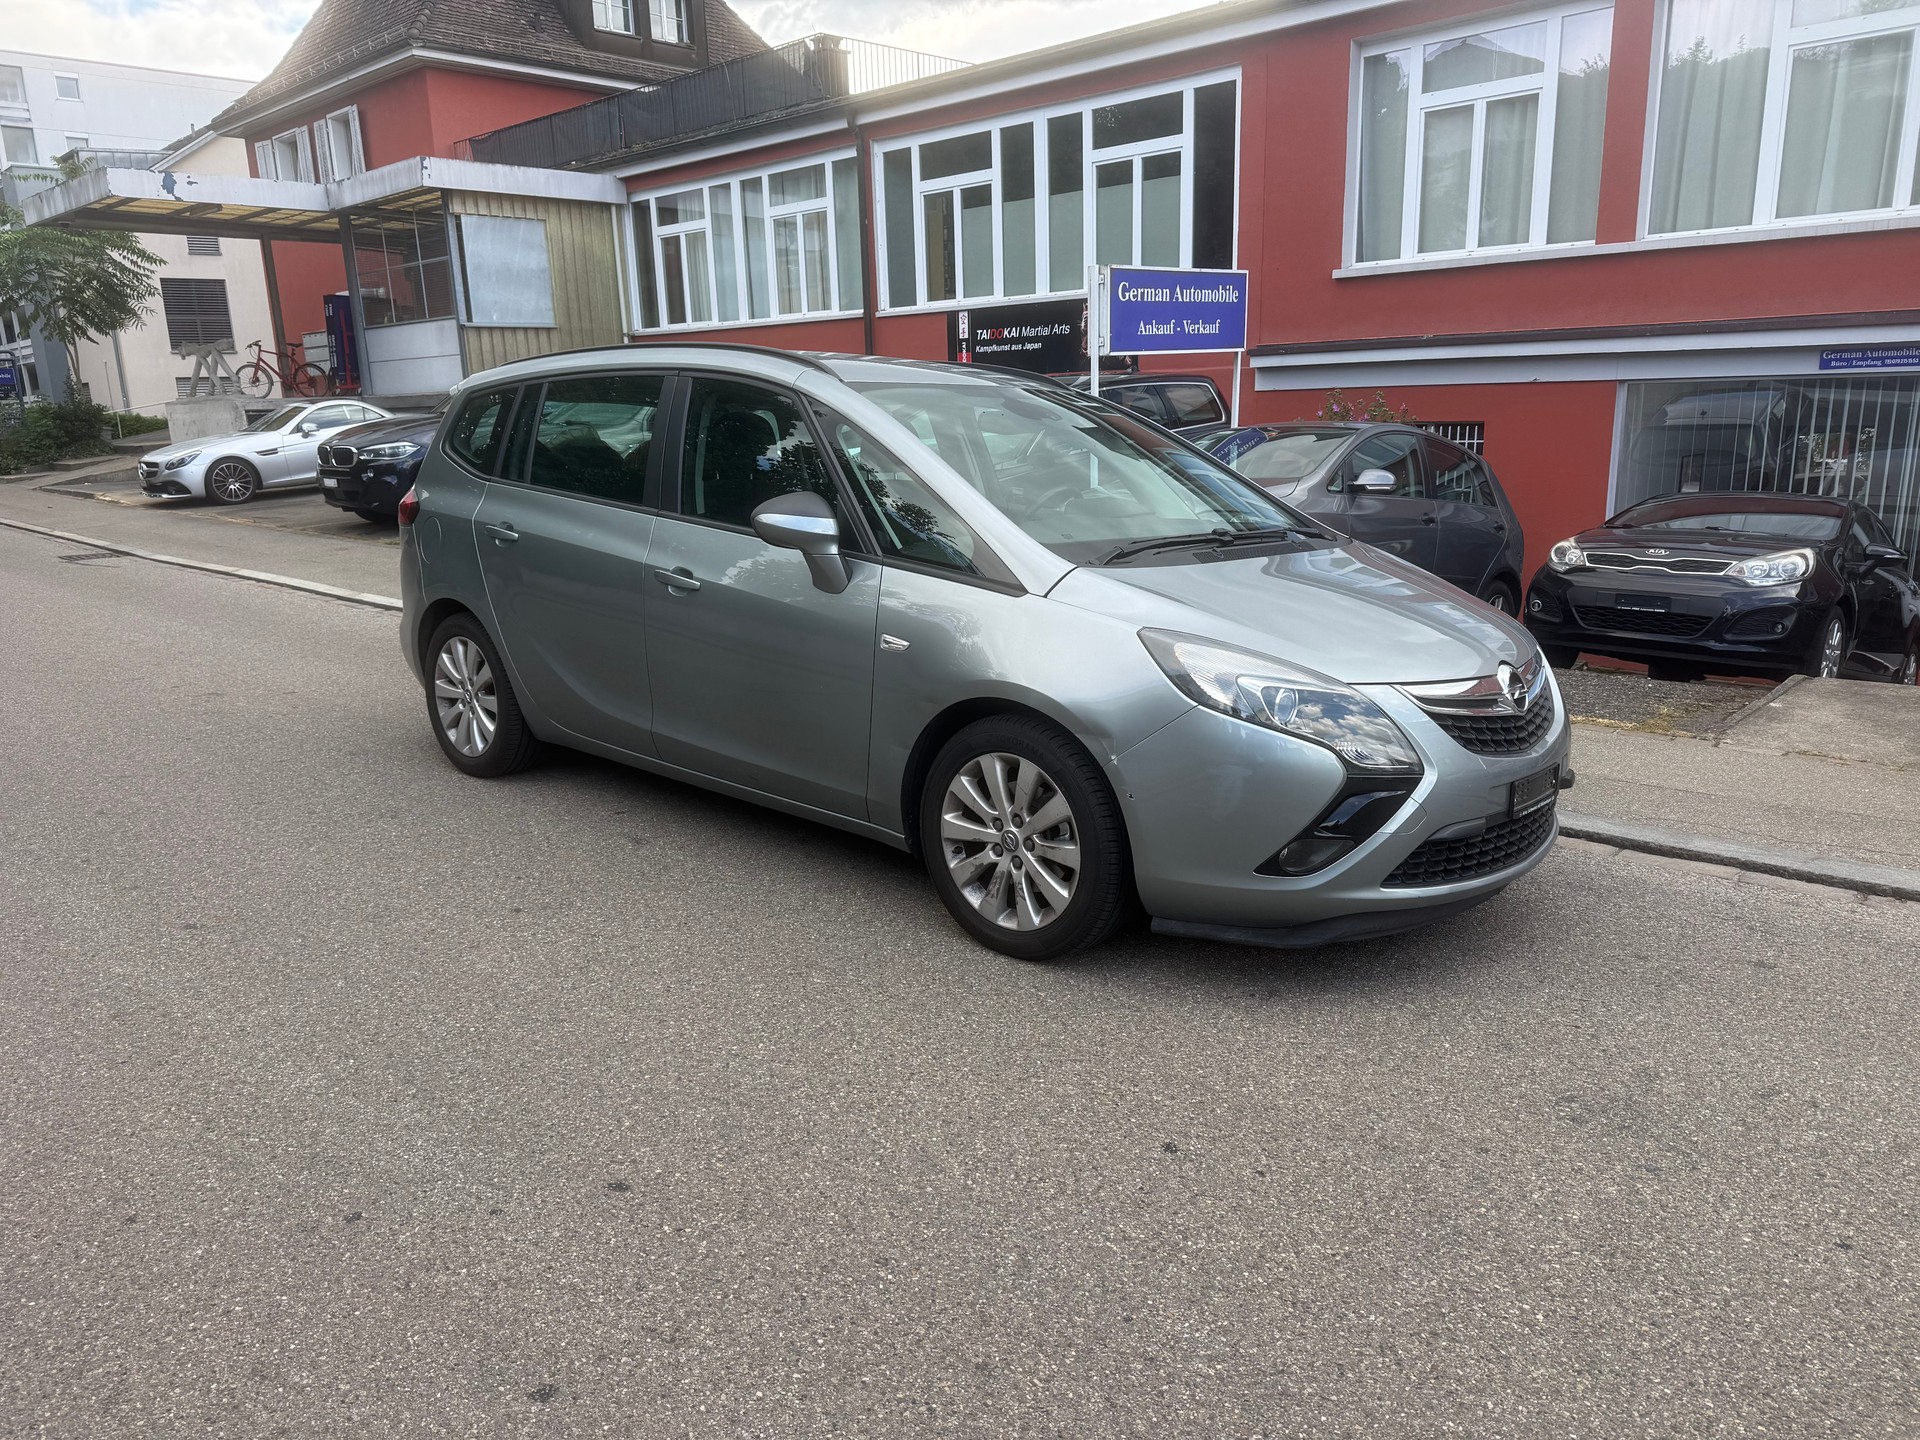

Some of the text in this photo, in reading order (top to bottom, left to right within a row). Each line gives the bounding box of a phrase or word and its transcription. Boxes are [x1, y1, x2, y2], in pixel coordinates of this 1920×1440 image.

[1118, 281, 1239, 303] German Automobile
[976, 323, 1071, 340] TAIDOKAI Martial Arts
[1137, 319, 1175, 335] Ankauf
[1182, 319, 1221, 334] Verkauf
[975, 343, 1011, 353] Kampfkunst
[1022, 341, 1042, 351] Japan
[1822, 347, 1920, 359] German Automobile
[1852, 359, 1882, 367] Empfang
